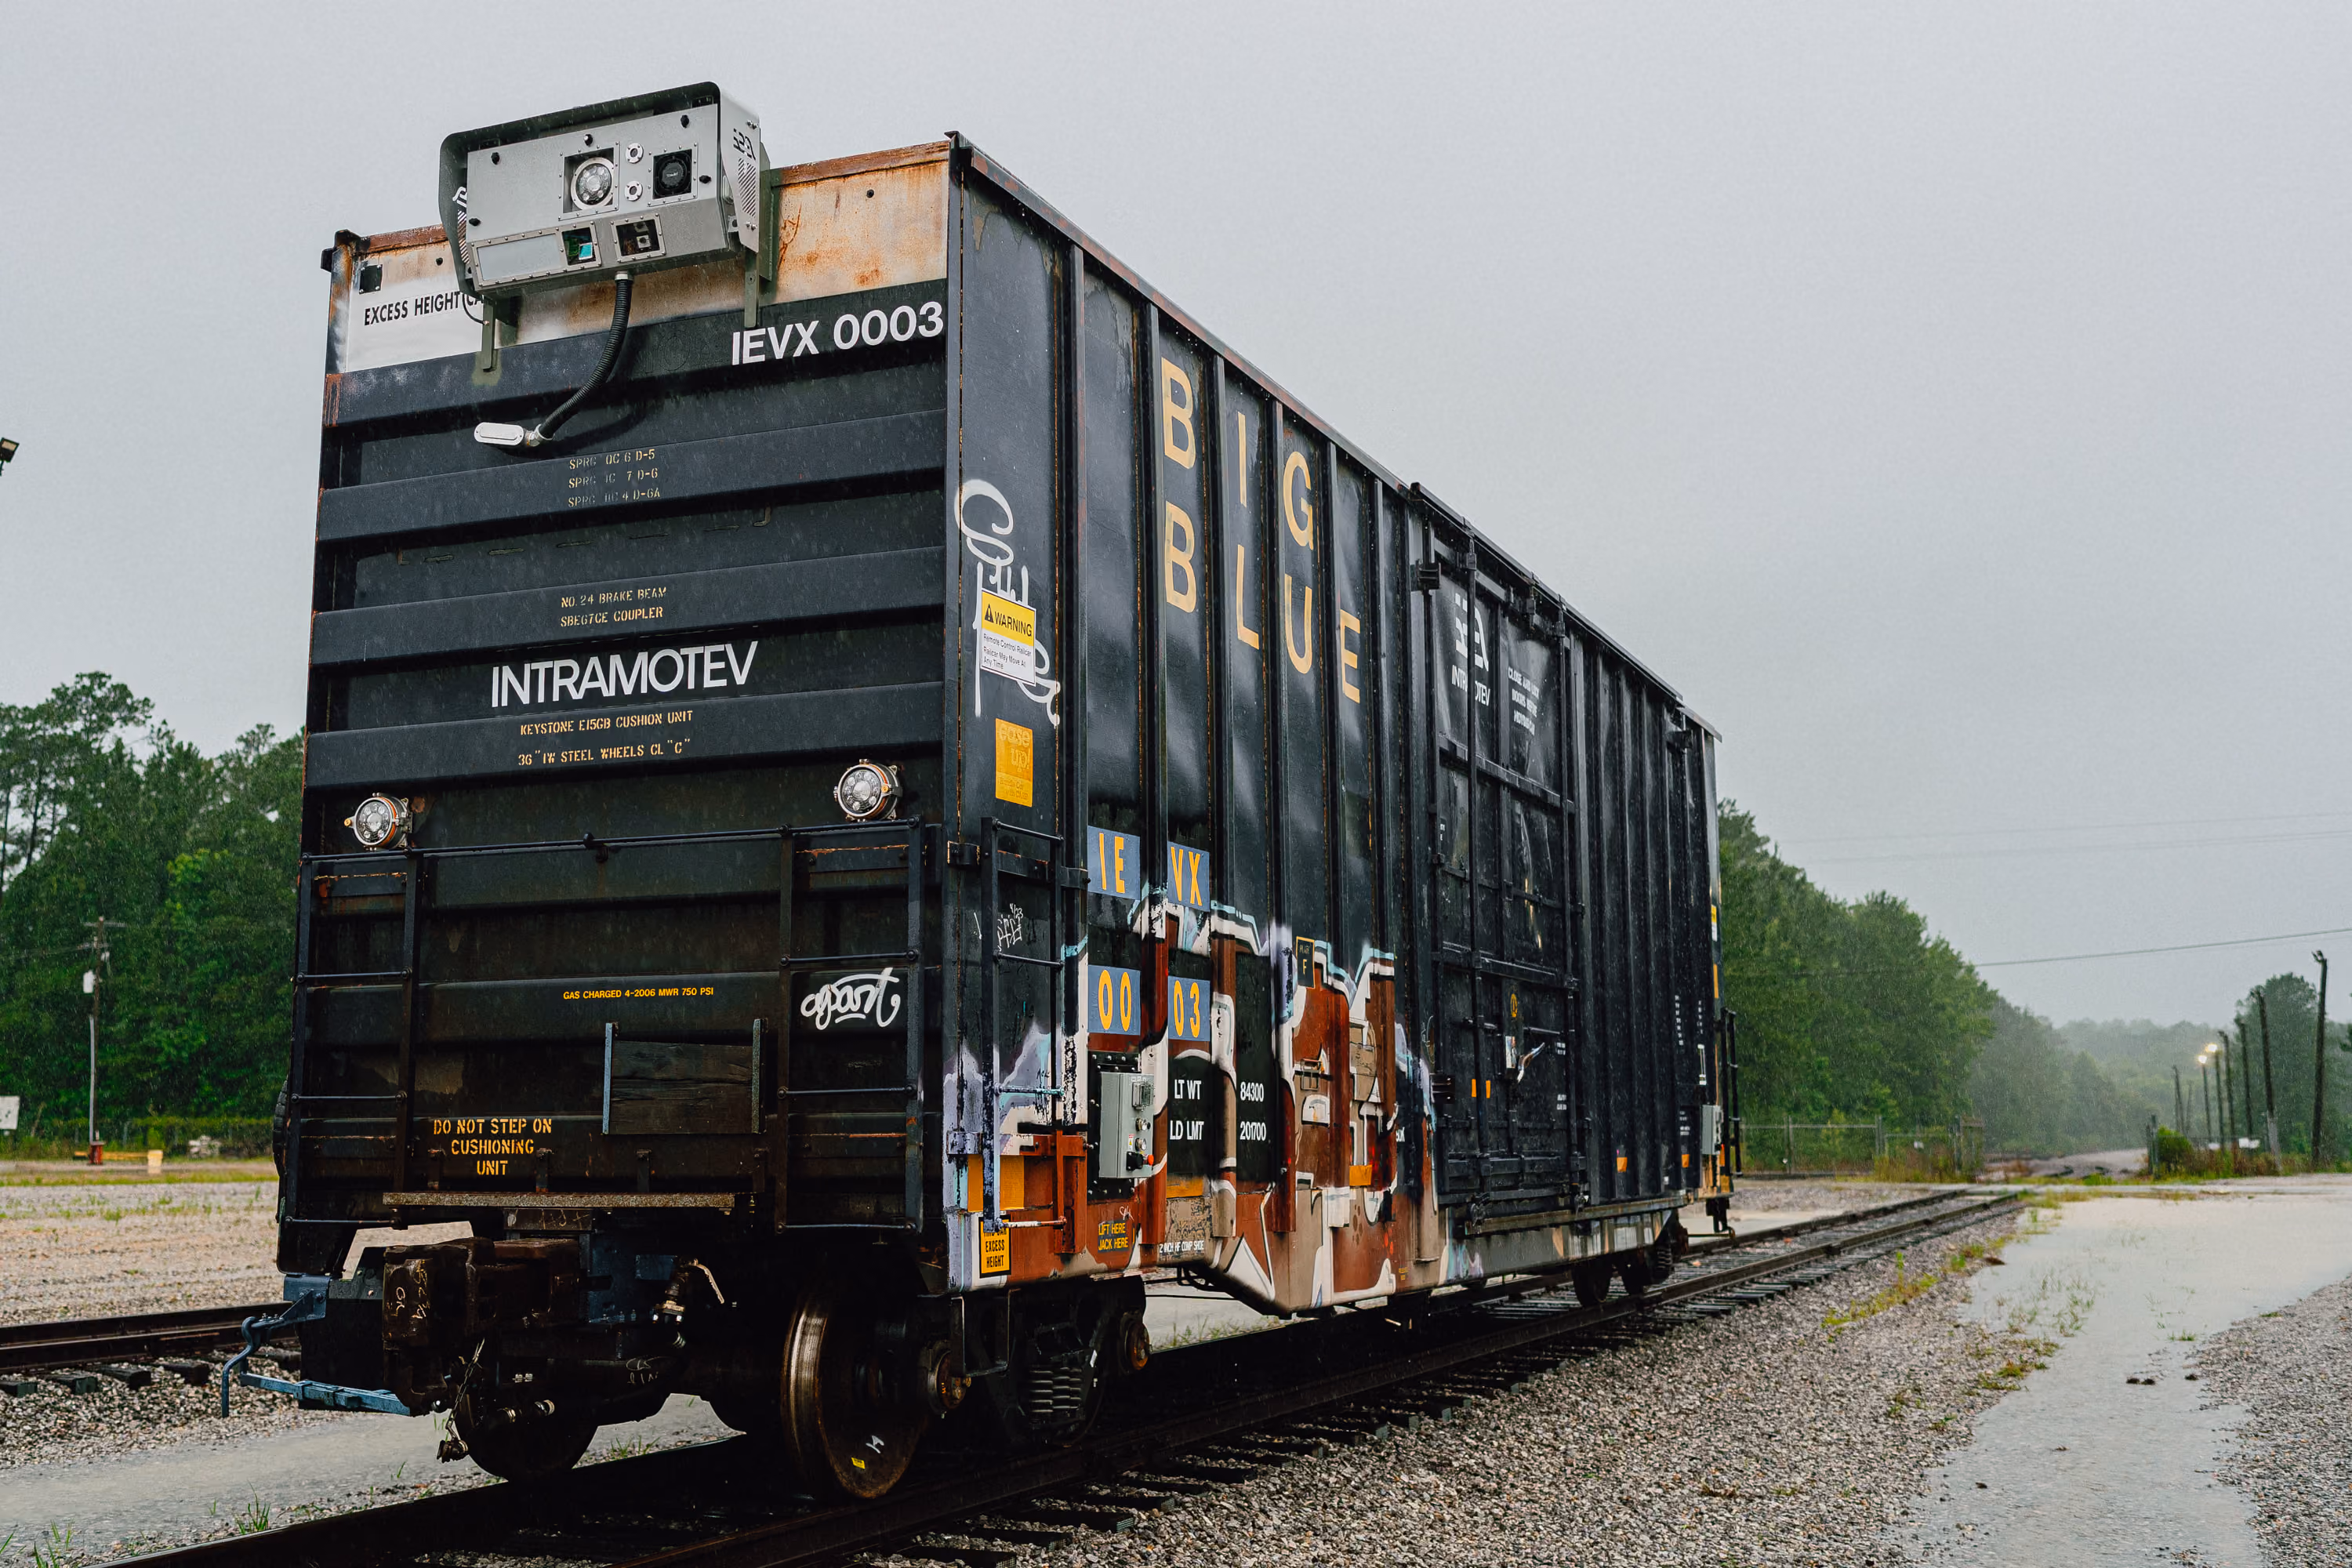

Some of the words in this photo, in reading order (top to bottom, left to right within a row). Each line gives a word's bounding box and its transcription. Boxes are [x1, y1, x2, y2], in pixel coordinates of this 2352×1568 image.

[365, 300, 408, 326] EXCESS
[415, 291, 460, 316] HEIGHT
[732, 321, 819, 365] IEVX
[833, 301, 943, 350] 0003
[636, 448, 655, 461] D-5
[1161, 357, 1315, 550] BIG
[580, 594, 594, 604] 24
[599, 590, 633, 604] BRAKE
[637, 586, 666, 601] BEAM
[1166, 501, 1360, 704] BLUE
[613, 606, 663, 622] COUPLER
[994, 611, 1033, 637] WARNING
[983, 633, 1000, 646] Remote
[1000, 640, 1016, 653] Control
[983, 645, 998, 657] Railcar
[999, 652, 1007, 662] May
[1008, 655, 1021, 666] Move
[983, 656, 992, 667] Any
[993, 659, 1004, 670] Time
[492, 641, 758, 708] INTRAMOTEV
[521, 720, 575, 735] KEYSTONE
[615, 713, 662, 728] CUSHION
[667, 710, 693, 724] UNIT
[561, 749, 594, 763] STEEL
[601, 744, 644, 760] WHEELS
[650, 742, 664, 756] CL
[1302, 959, 1308, 975] F
[563, 991, 580, 1000] GAS
[583, 989, 622, 999] CHARGED
[624, 989, 656, 997] 4-2006
[658, 988, 679, 996] MWR
[681, 987, 697, 996] 750
[700, 987, 713, 996] PSI
[1098, 969, 1132, 1032] 00
[1174, 980, 1200, 1038] 03
[1174, 1079, 1185, 1099] LT
[1186, 1080, 1202, 1100] WT
[1240, 1081, 1265, 1102] 84300
[434, 1119, 452, 1134] DO
[456, 1119, 485, 1134] NOT
[490, 1118, 527, 1134] STEP
[532, 1118, 553, 1134] ON
[1169, 1120, 1184, 1140] LD
[1186, 1120, 1205, 1140] LMT
[1240, 1121, 1267, 1142] 201700
[451, 1138, 534, 1155] CUSHIONING
[477, 1160, 509, 1175] UNIT
[1111, 1222, 1127, 1234] HERE
[985, 1239, 1005, 1253] EXCESS
[1098, 1238, 1112, 1250] JACK
[1113, 1236, 1129, 1249] HERE
[1159, 1243, 1163, 1253] 2
[1193, 1240, 1204, 1251] SHOE
[986, 1254, 1004, 1268] HEIGHT
